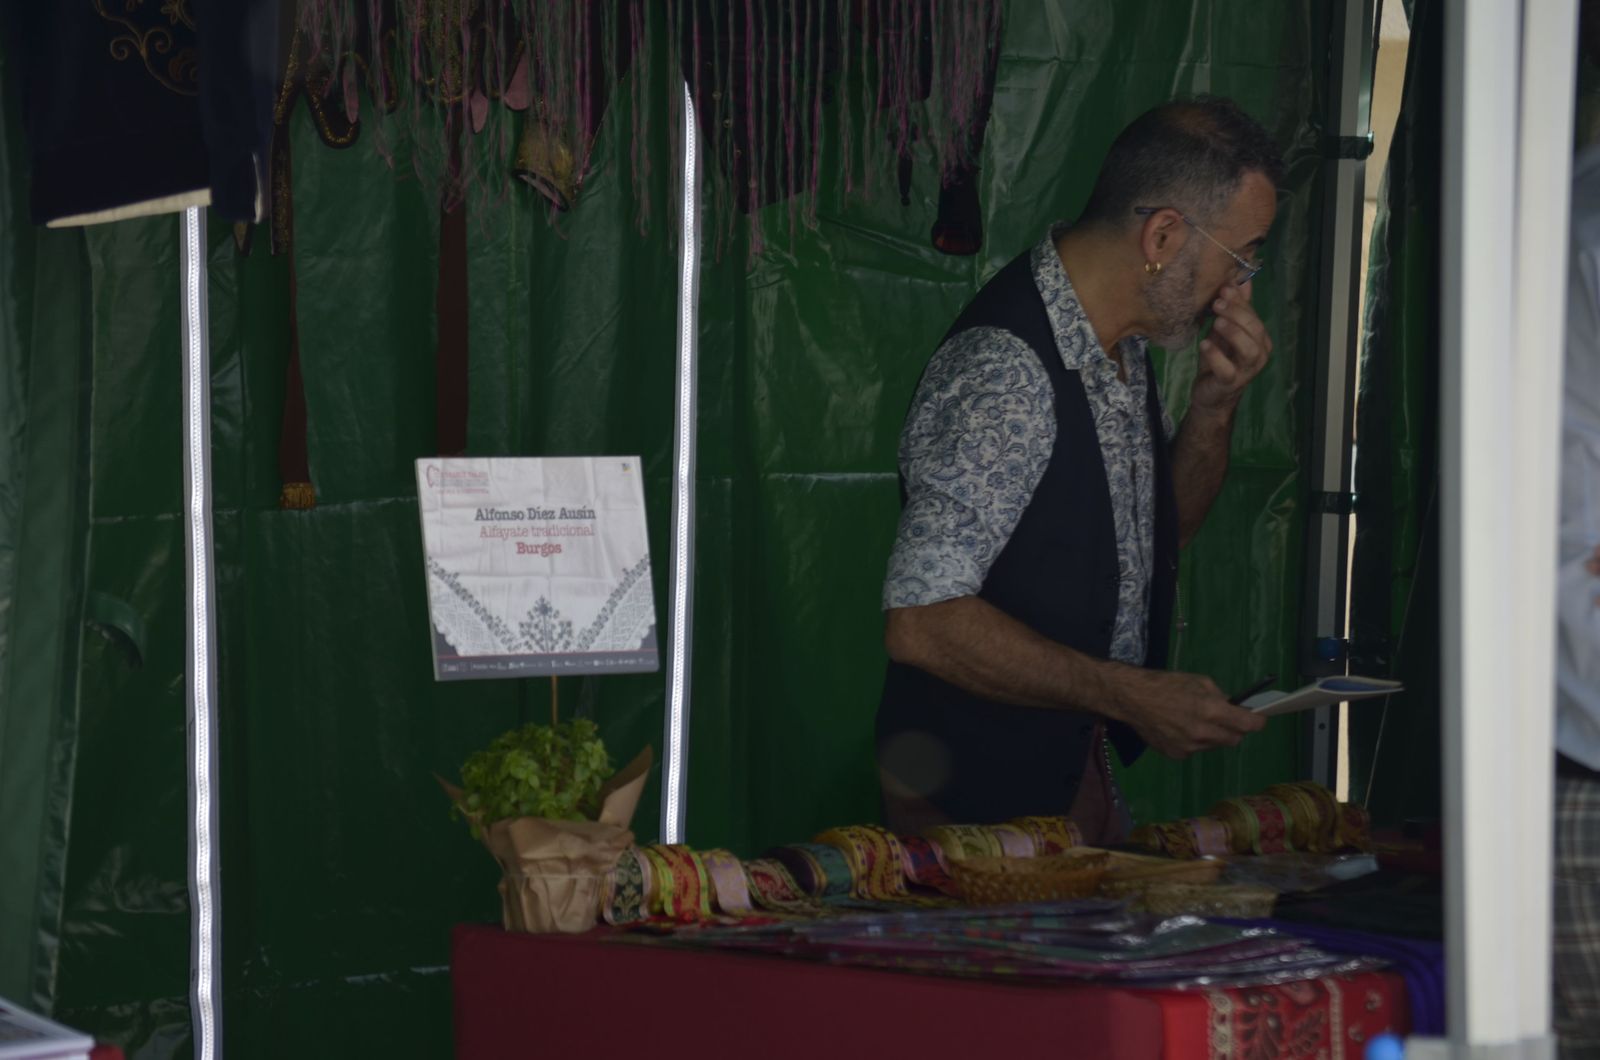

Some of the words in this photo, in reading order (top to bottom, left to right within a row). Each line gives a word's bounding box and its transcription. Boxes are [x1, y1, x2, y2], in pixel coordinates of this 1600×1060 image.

[475, 507, 524, 521] Alfonso
[558, 505, 596, 520] Ausín
[480, 525, 528, 540] Alfayate
[531, 524, 594, 538] tradicional
[515, 541, 562, 557] Burgos
